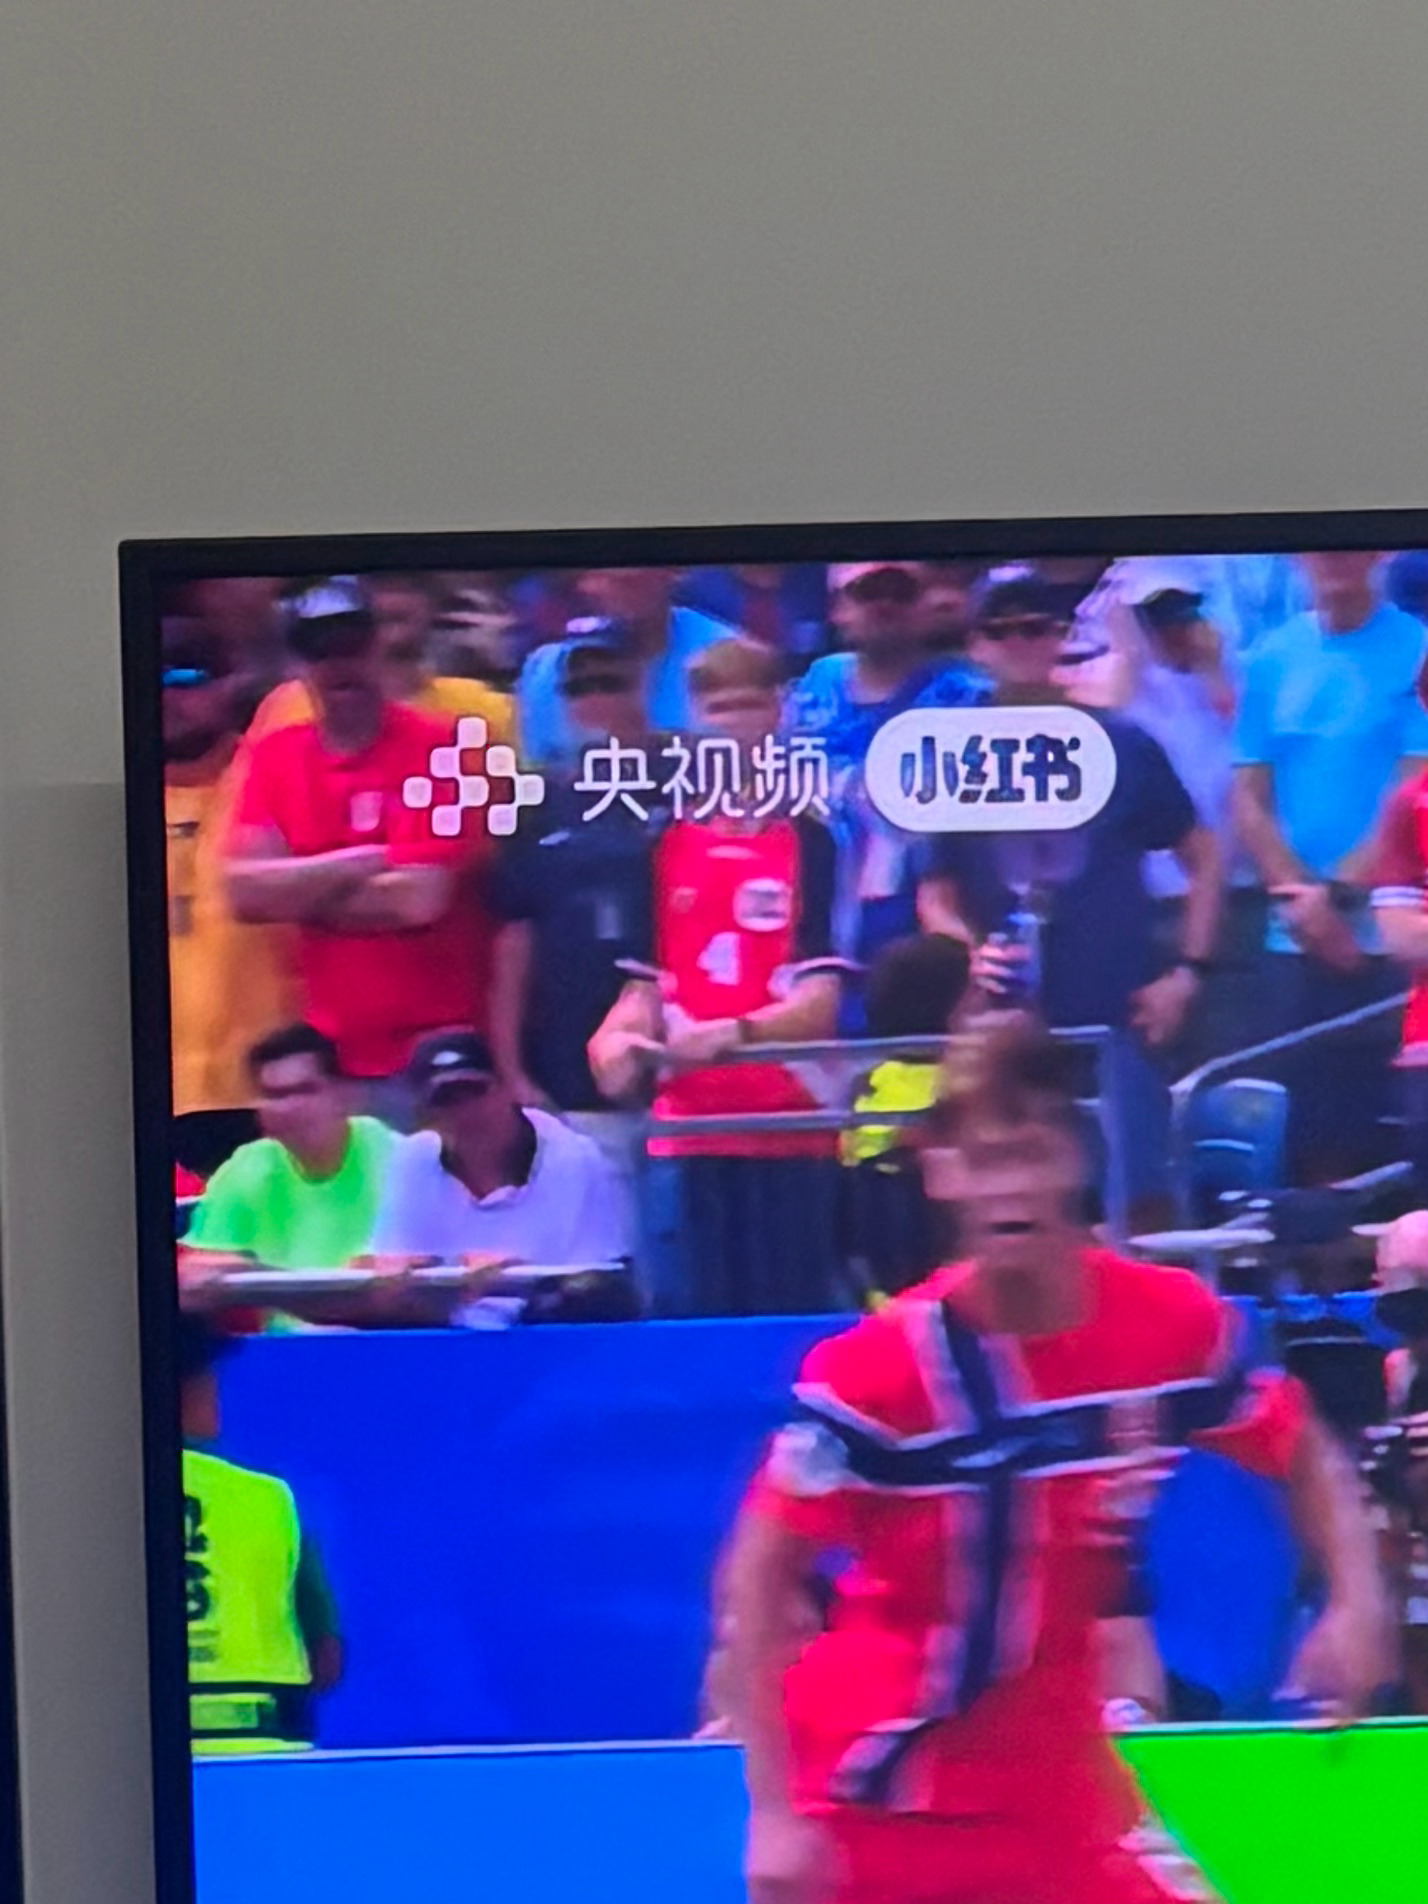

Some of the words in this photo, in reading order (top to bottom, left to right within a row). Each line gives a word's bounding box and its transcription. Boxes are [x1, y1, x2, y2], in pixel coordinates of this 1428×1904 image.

[573, 735, 831, 820] 央视频
[898, 733, 1084, 804] 小红书
